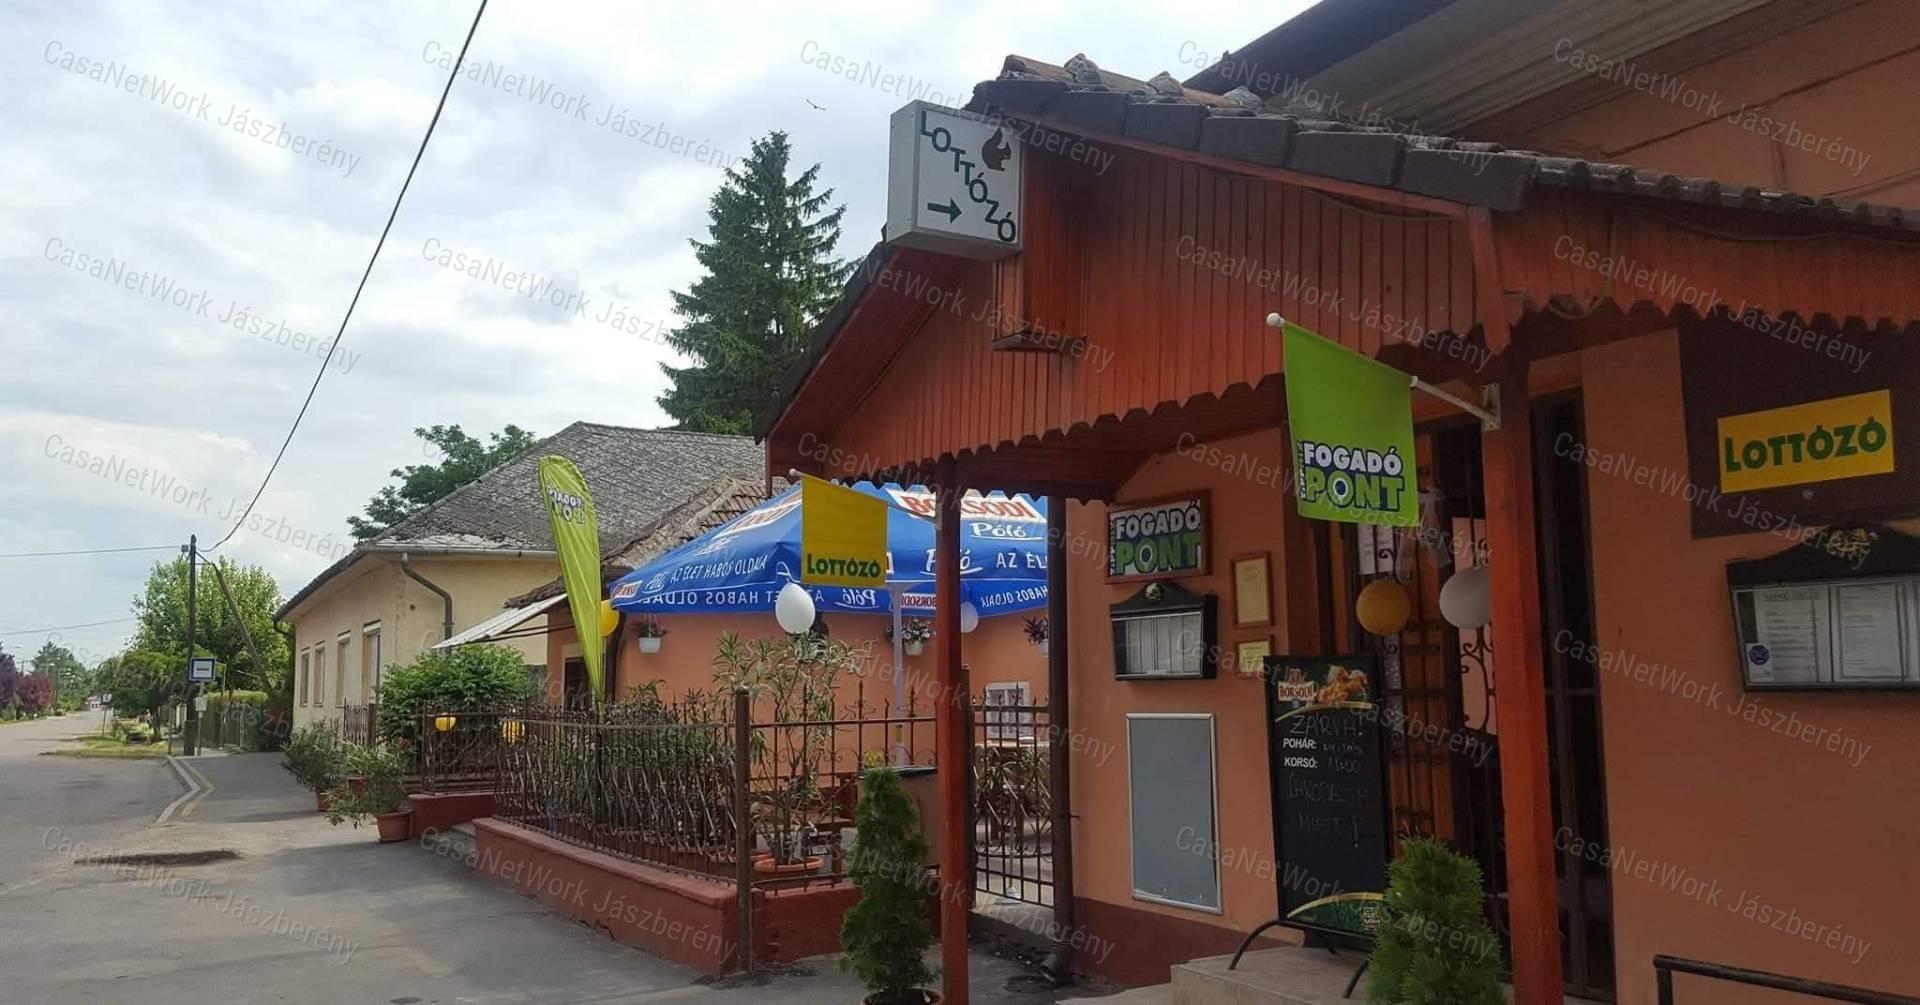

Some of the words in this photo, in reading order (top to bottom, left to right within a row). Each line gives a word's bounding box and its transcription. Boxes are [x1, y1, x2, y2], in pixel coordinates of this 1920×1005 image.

[921, 110, 1016, 242] LOTTÓZÓ
[1724, 416, 1887, 473] LOTTÓZÓ
[1303, 442, 1403, 477] FOGADÓ
[1304, 466, 1405, 511] PONT
[900, 496, 1037, 519] BOSODI
[1115, 500, 1201, 540] FOGADÓ
[807, 553, 881, 578] LOTTÓZÓ
[996, 553, 1018, 569] AZ
[1115, 533, 1201, 576] PONT
[705, 560, 733, 579] HABOS
[1280, 685, 1313, 698] BORSODI
[1283, 737, 1317, 750] POHÁR:
[1284, 756, 1319, 769] KORSÓ:
